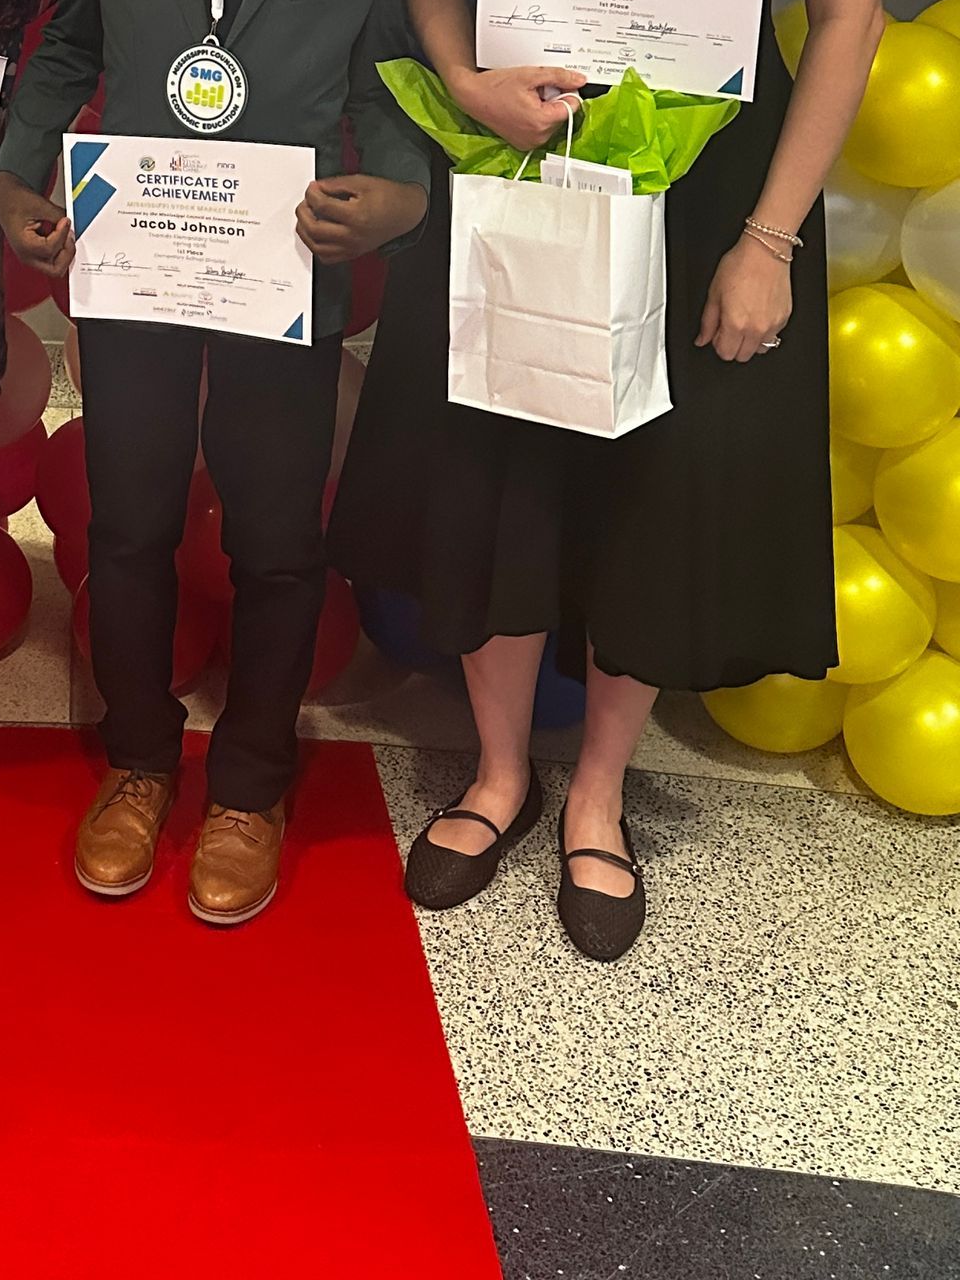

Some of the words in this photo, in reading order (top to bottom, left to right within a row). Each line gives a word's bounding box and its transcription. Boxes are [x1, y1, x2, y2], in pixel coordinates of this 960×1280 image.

[172, 49, 208, 75] MISSISSIPPI
[210, 51, 238, 75] COUNCIL
[234, 76, 241, 88] ON
[190, 67, 222, 81] SMG
[170, 94, 200, 128] ECONOMIC
[202, 104, 240, 129] EDUCATION
[136, 174, 218, 188] CERTIFICATE
[222, 179, 239, 189] OF
[142, 188, 235, 202] ACHIEVEMENT
[130, 218, 176, 230] Jacob
[181, 222, 245, 236] Johnson
